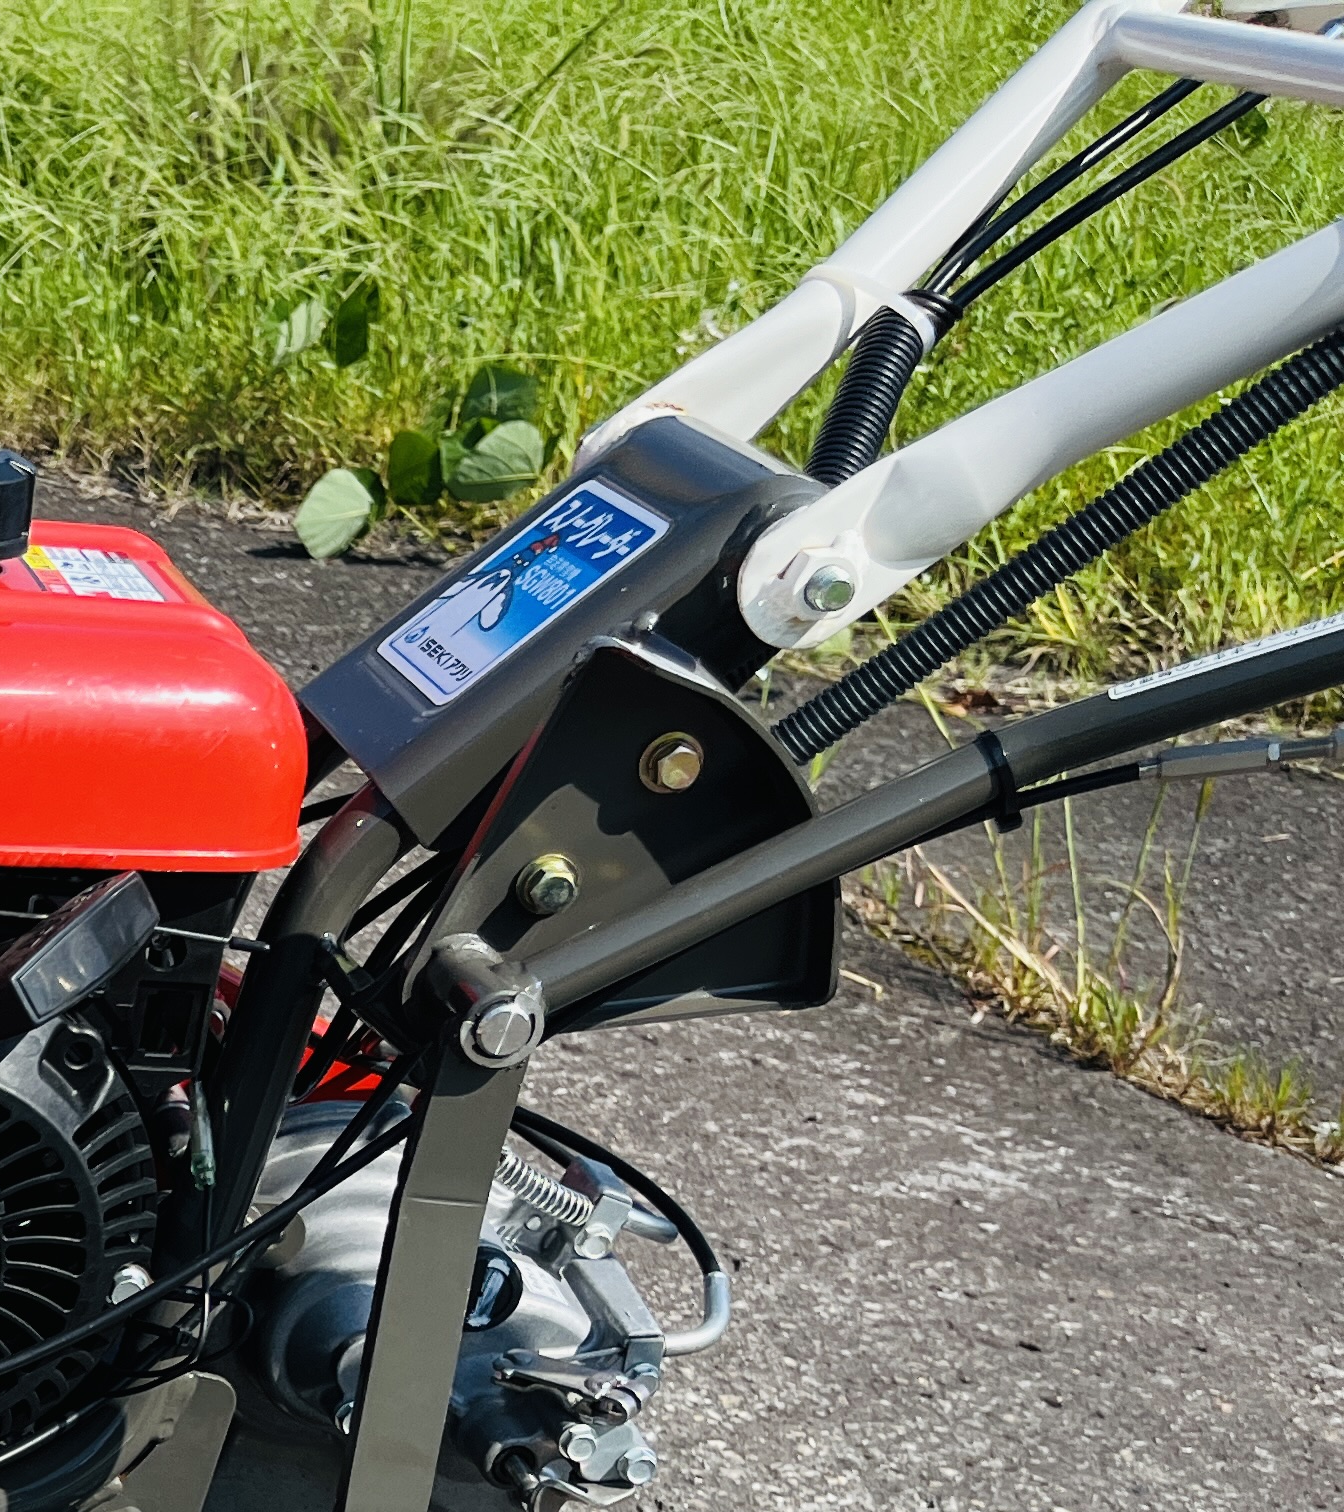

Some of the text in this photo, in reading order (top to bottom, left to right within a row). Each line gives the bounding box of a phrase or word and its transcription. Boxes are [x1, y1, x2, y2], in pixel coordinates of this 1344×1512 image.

[545, 499, 643, 560] スノーグレーダー
[512, 563, 578, 610] SGW801
[416, 635, 454, 667] ISEKI
